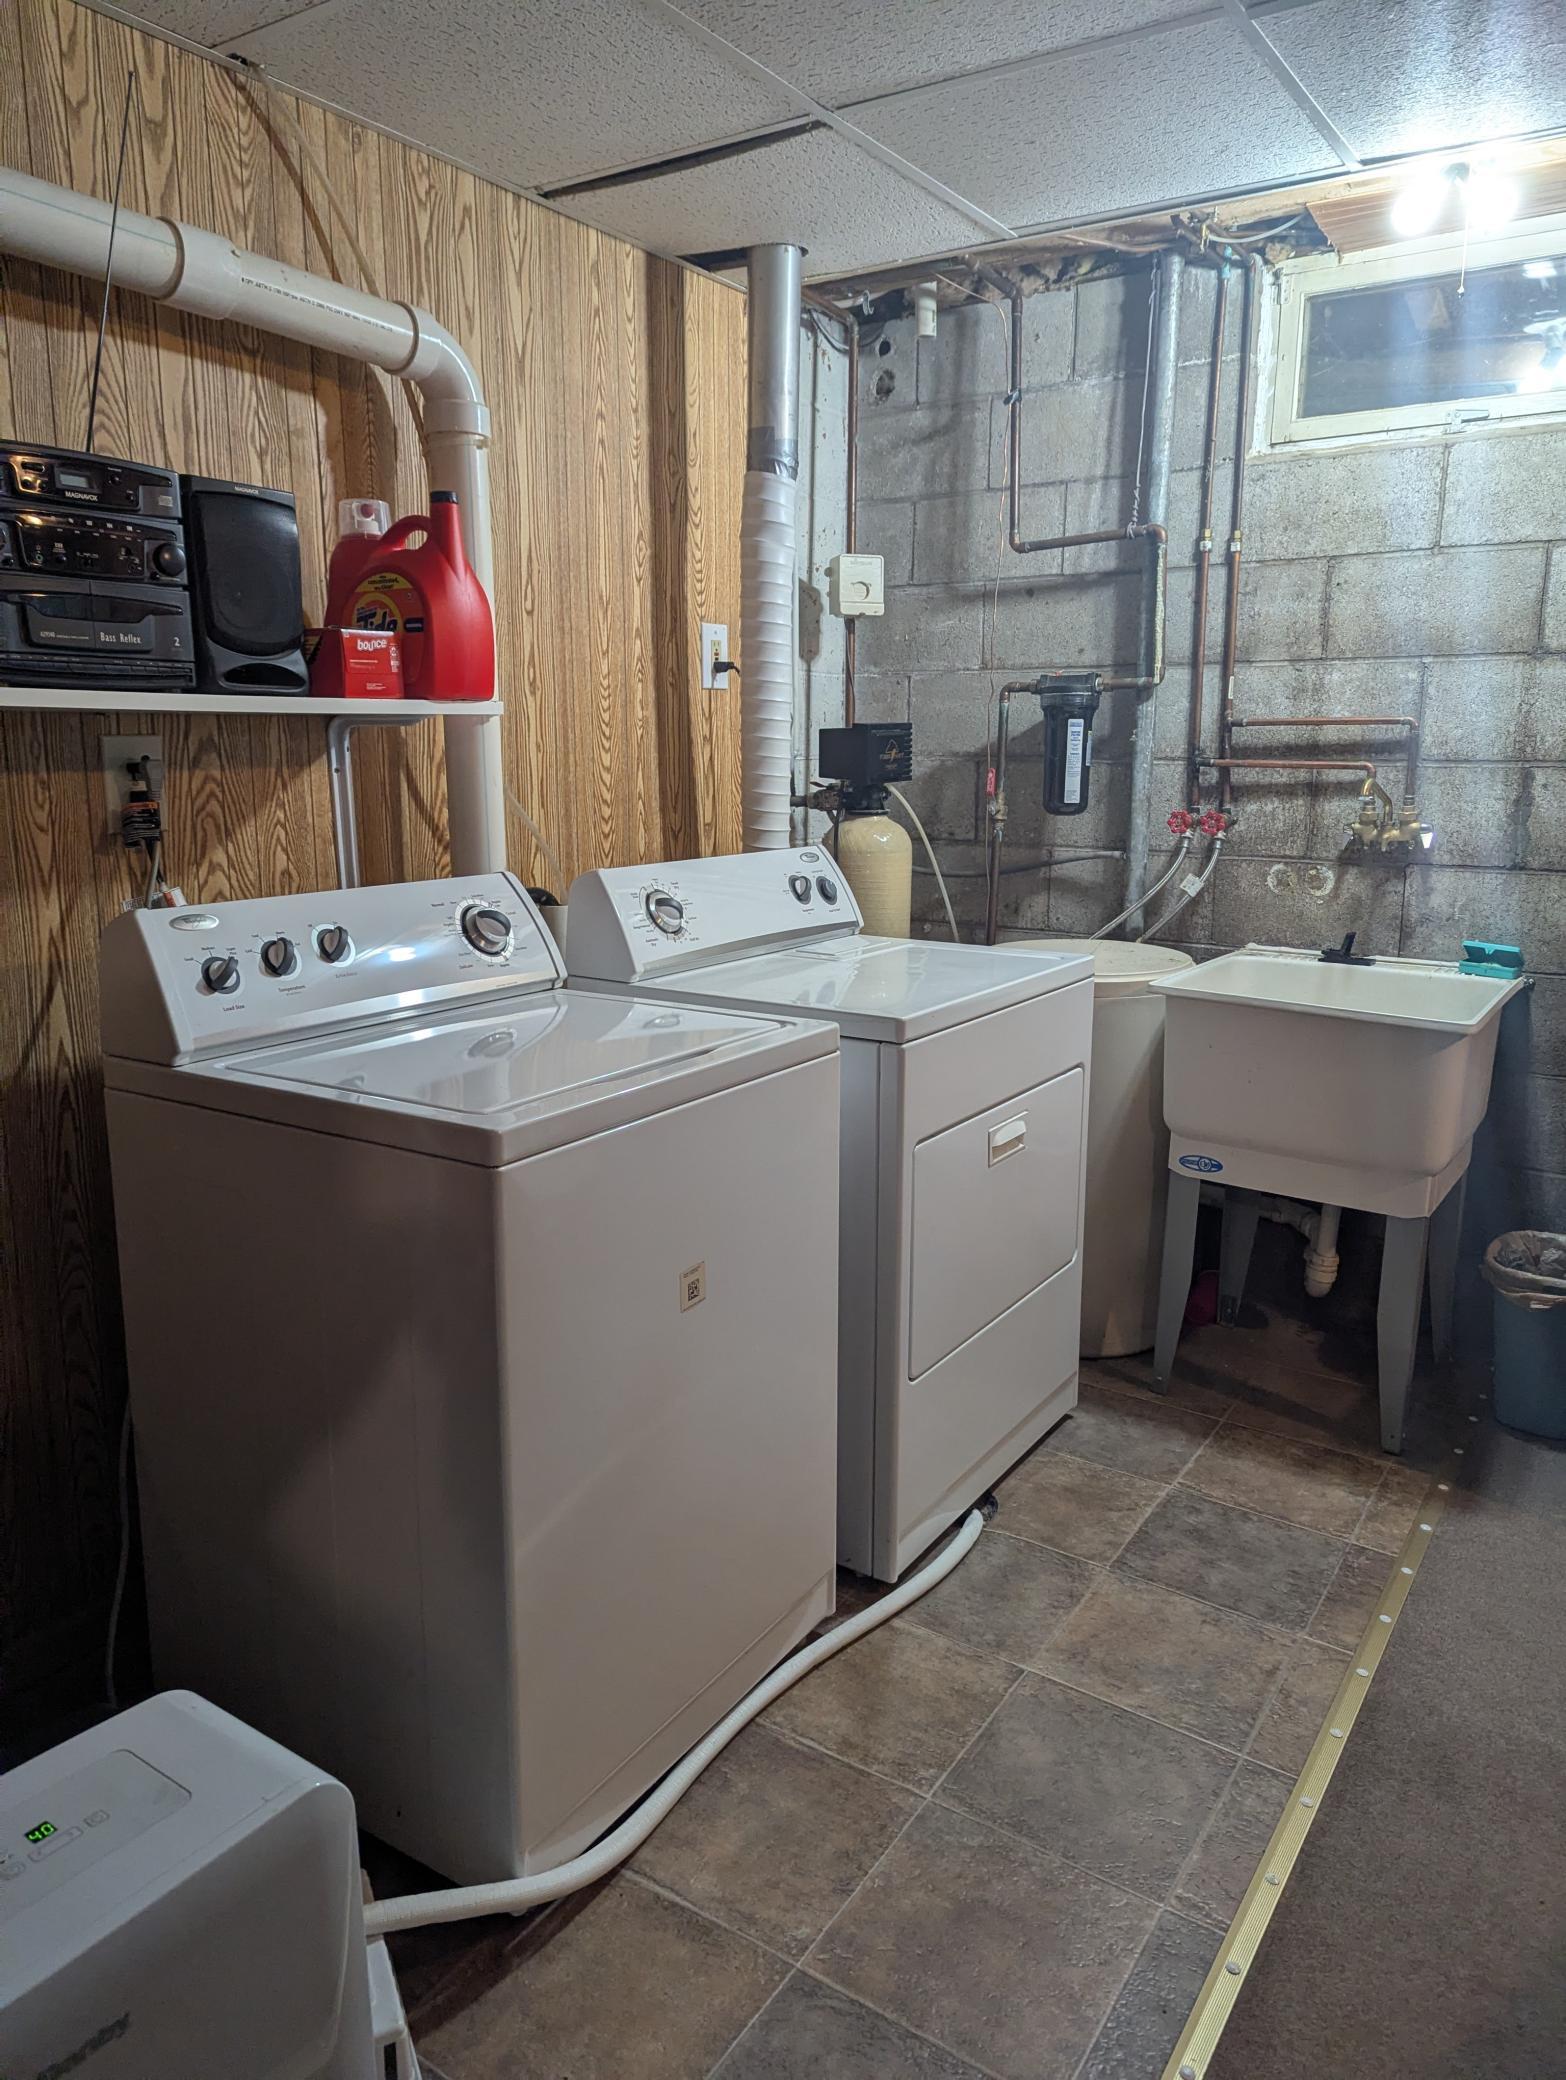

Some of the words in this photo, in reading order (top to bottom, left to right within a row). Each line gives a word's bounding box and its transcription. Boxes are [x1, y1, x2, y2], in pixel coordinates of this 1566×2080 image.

[65, 490, 98, 502] MAGNAVOX
[100, 631, 117, 643] Bass
[119, 633, 142, 644] Reflex
[173, 637, 181, 646] 2
[357, 639, 388, 651] bounce
[28, 1823, 55, 1840] 40
